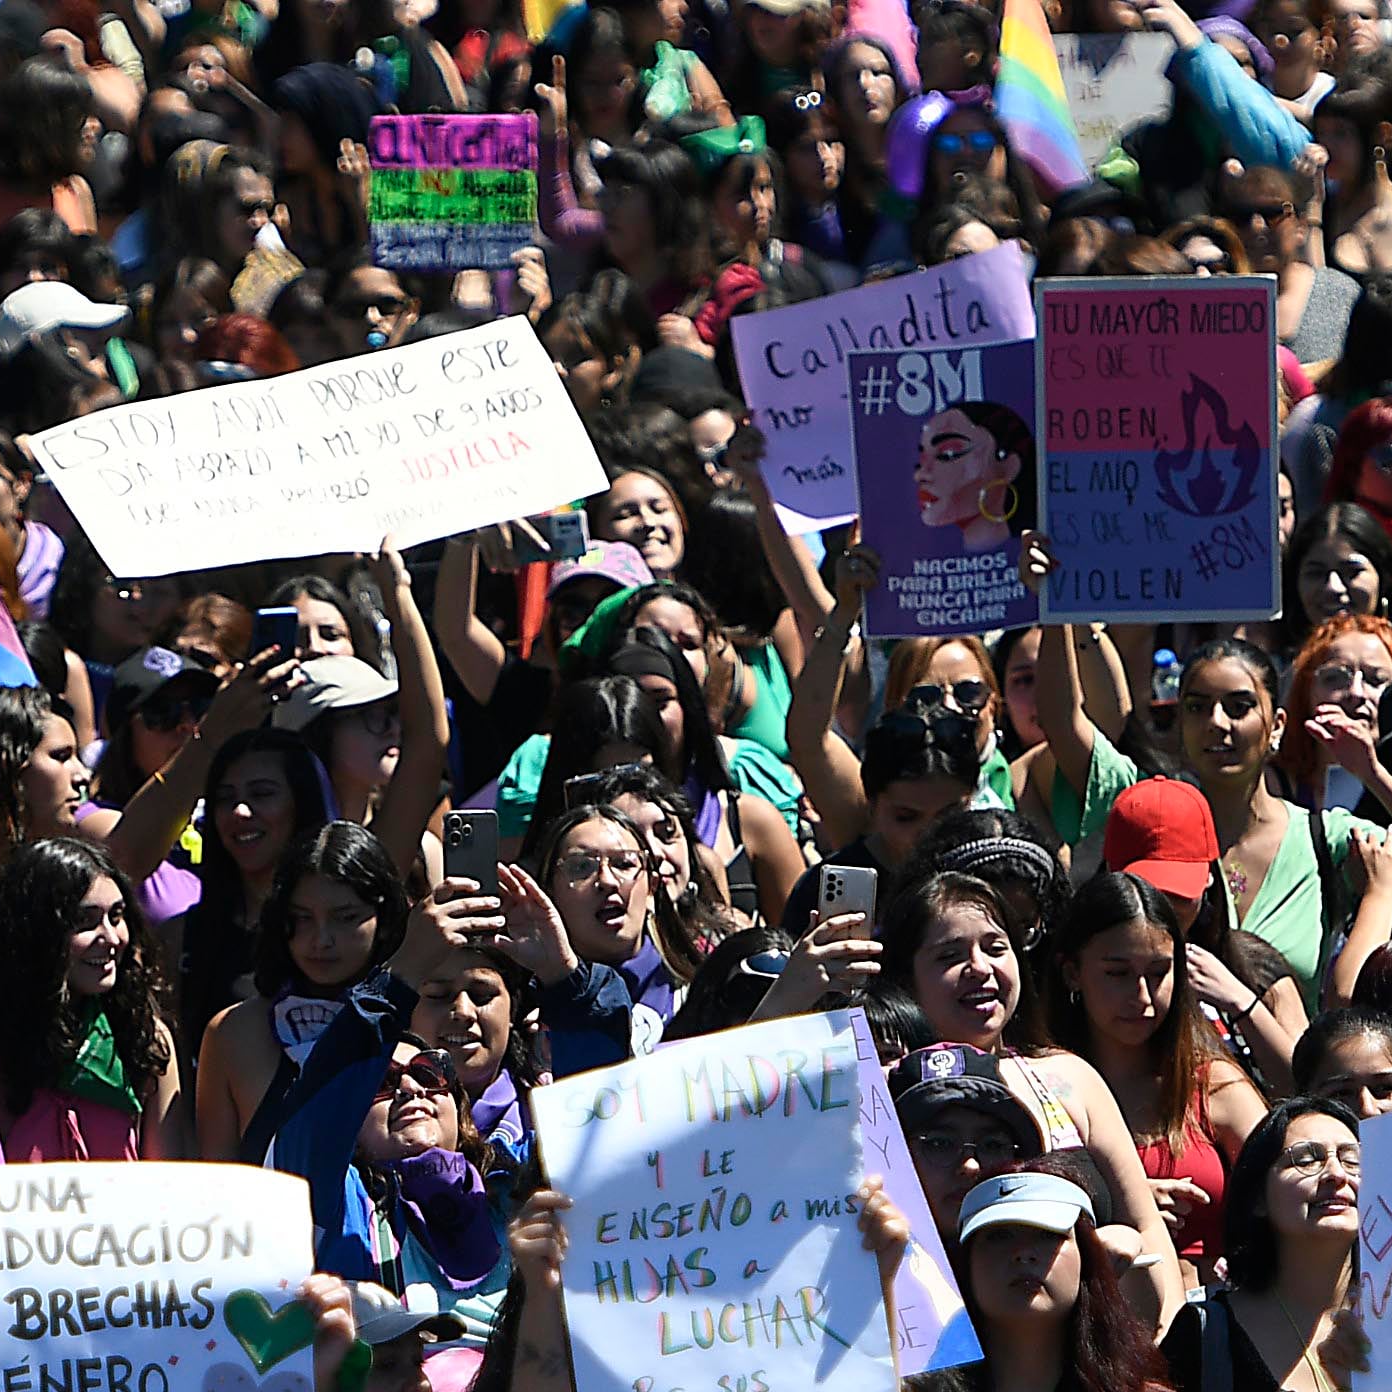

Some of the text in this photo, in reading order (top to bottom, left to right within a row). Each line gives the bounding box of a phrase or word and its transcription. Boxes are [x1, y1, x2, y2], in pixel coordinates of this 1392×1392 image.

[1047, 297, 1267, 335] TU MAYOR MIEDO
[484, 386, 544, 421] AÑOS
[860, 349, 985, 418] #8M
[42, 410, 177, 470] ESTOY
[1048, 461, 1077, 494] EL
[913, 552, 1008, 575] NACIMOS
[1190, 515, 1268, 582] #8M
[888, 567, 1019, 593] PARA BRILLA
[899, 591, 969, 609] NUNCA
[1048, 568, 1184, 602] VIOLEN
[563, 1075, 648, 1129] SOY
[682, 1045, 850, 1123] MADRE
[701, 1148, 736, 1179] LE
[595, 1186, 753, 1245] ENSEÑO
[592, 1246, 718, 1306] HIJAS
[3, 1277, 216, 1342] BRECHAS
[658, 1285, 853, 1356] LUCHAR
